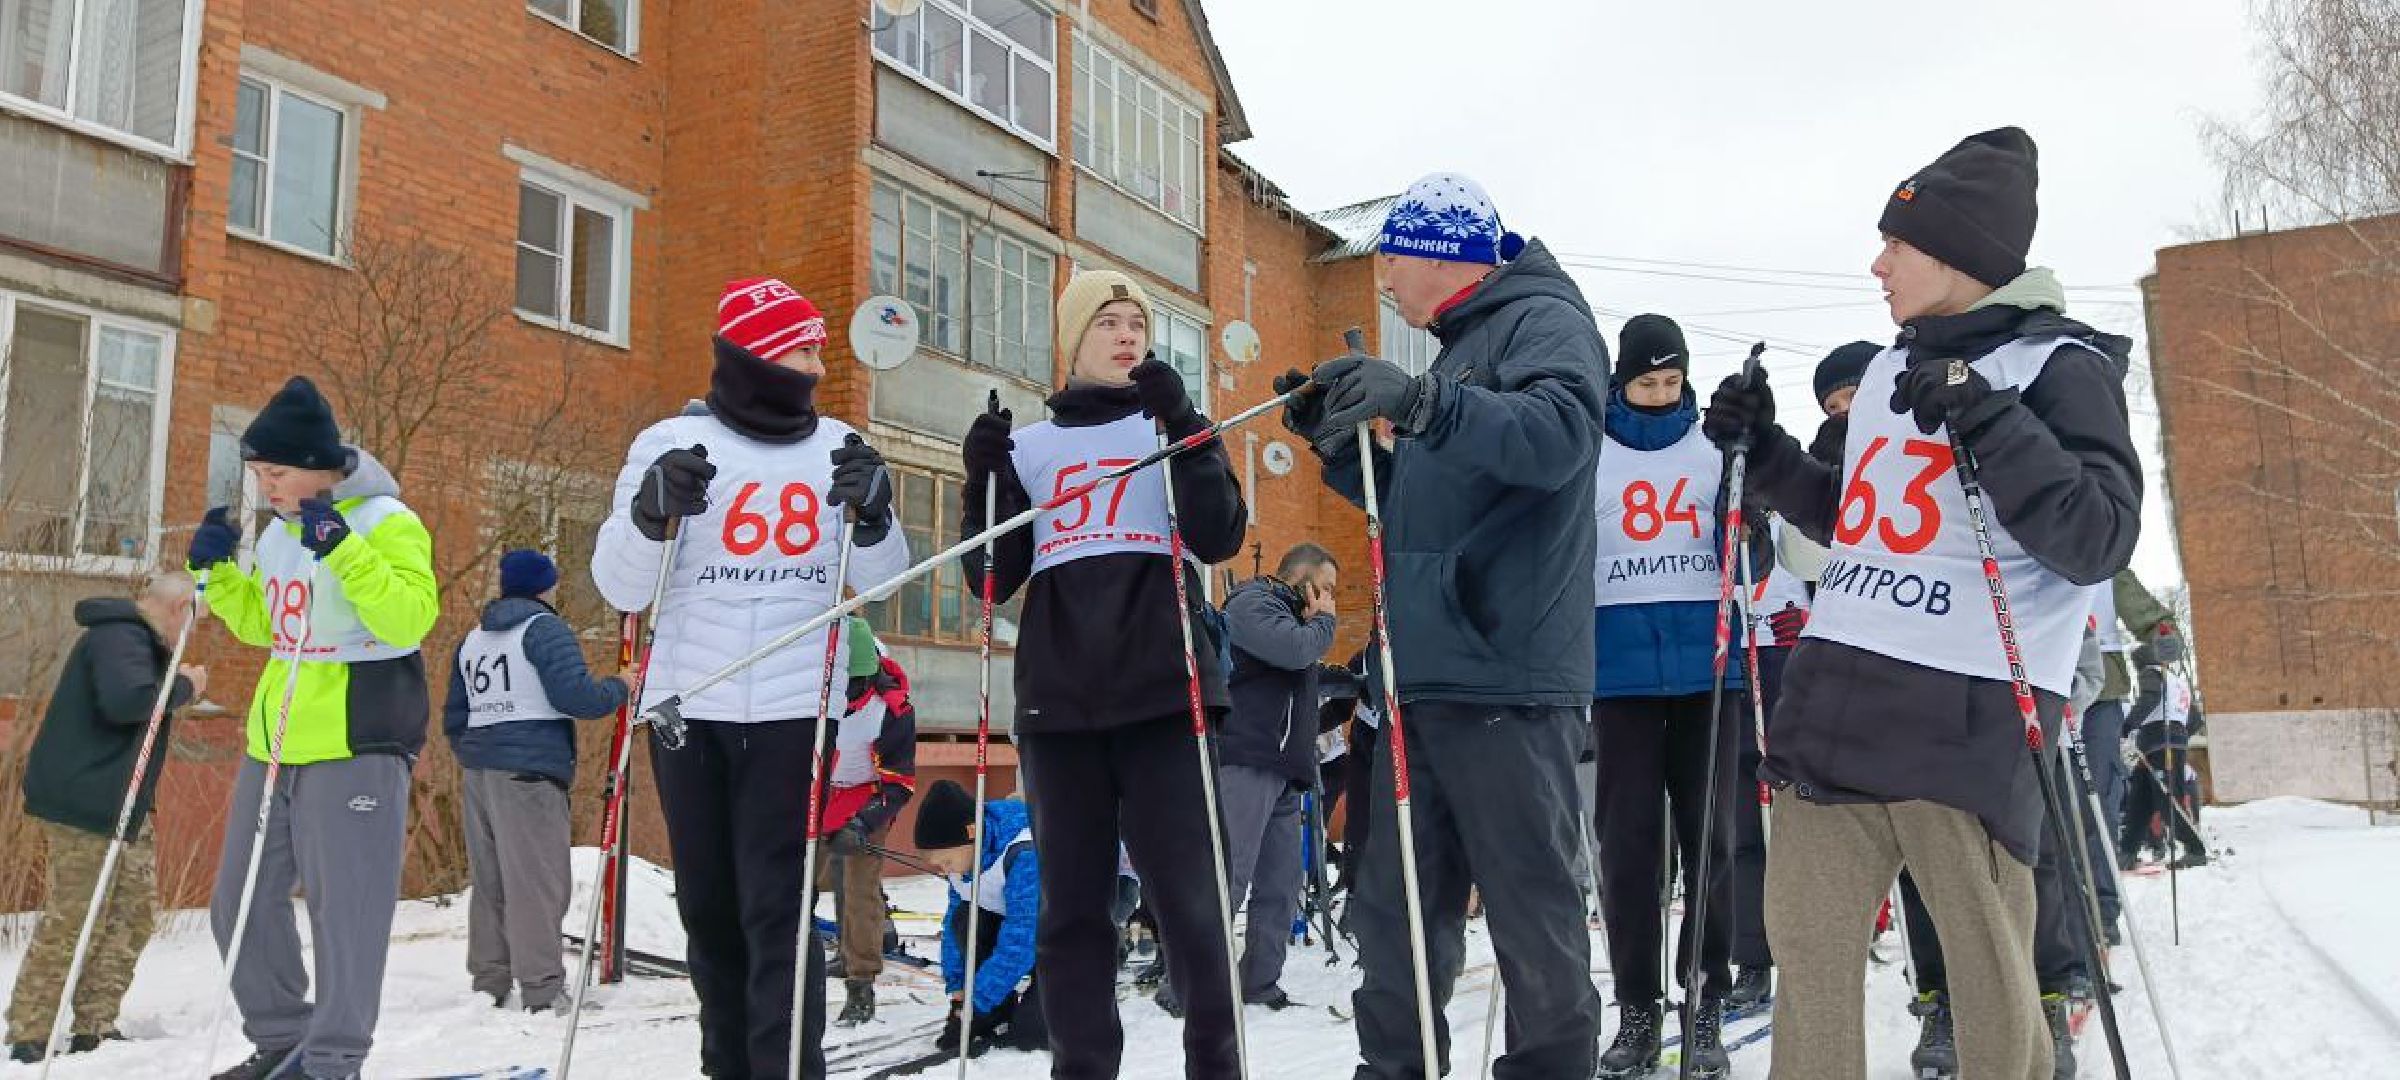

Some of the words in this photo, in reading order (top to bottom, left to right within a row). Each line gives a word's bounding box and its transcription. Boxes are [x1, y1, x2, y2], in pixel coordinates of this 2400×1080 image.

[721, 482, 821, 556] 68
[1053, 458, 1141, 533] 57
[1622, 477, 1701, 542] 84
[1835, 436, 1956, 554] 63
[1608, 553, 1717, 583] ДМИТРОВ
